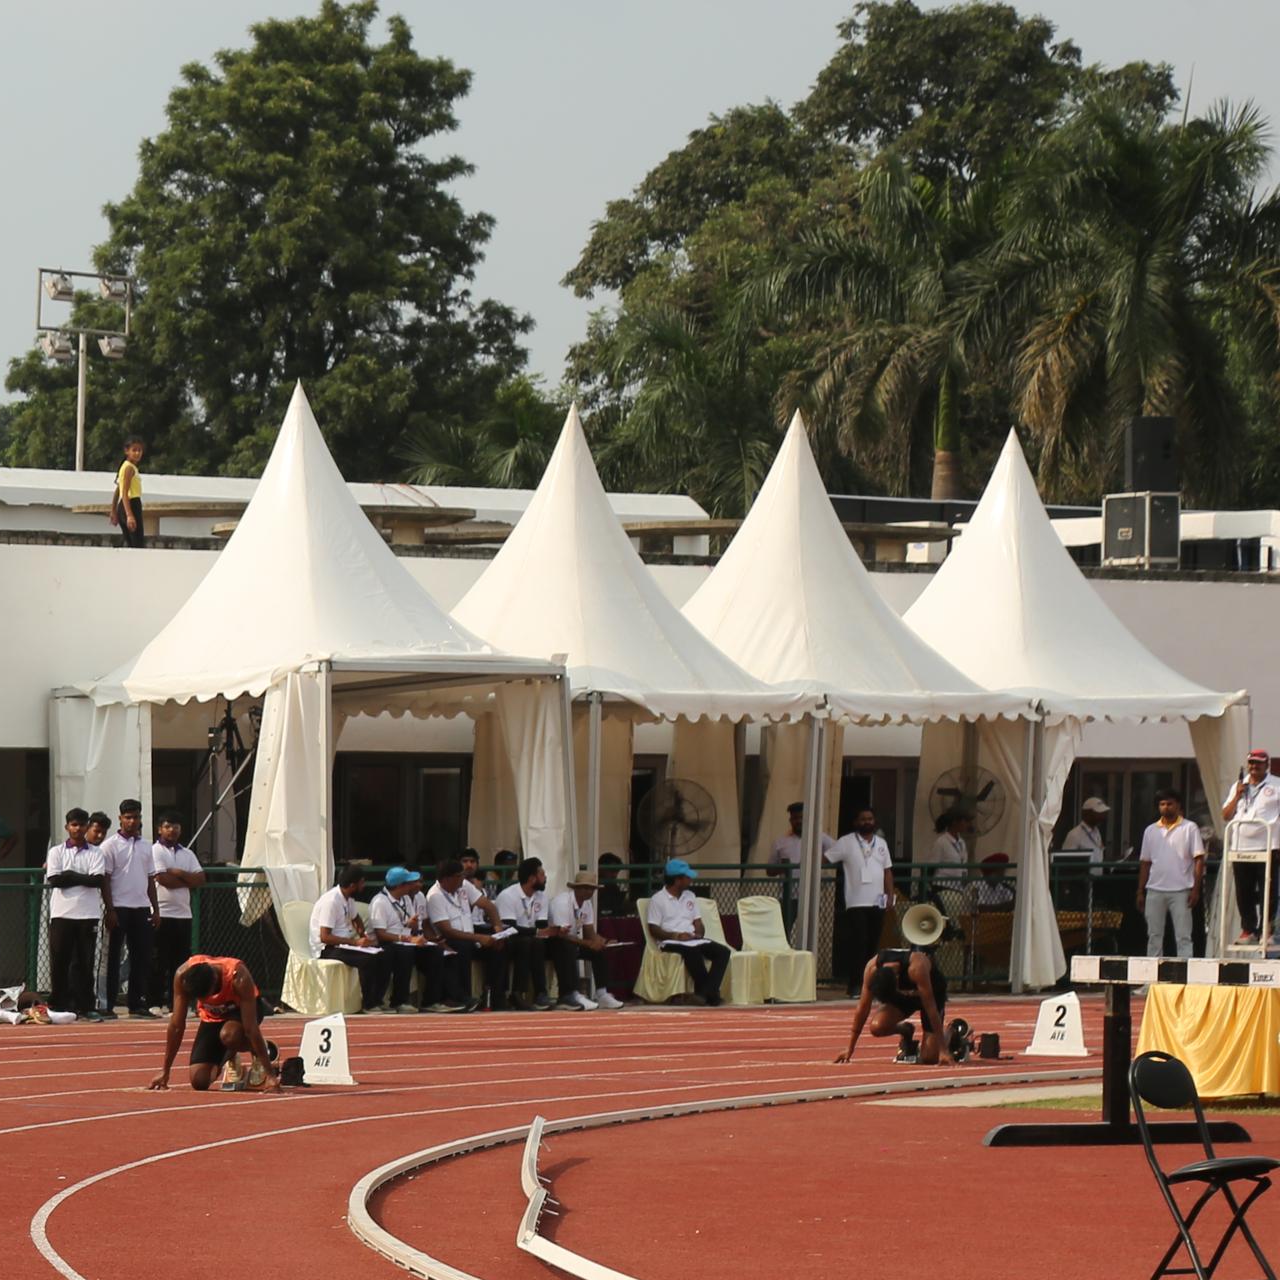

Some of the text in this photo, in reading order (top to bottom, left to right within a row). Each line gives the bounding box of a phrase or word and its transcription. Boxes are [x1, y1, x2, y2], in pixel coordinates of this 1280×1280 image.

[1054, 1004, 1067, 1027] 2
[319, 1028, 332, 1053] 3
[314, 1056, 331, 1067] ATE
